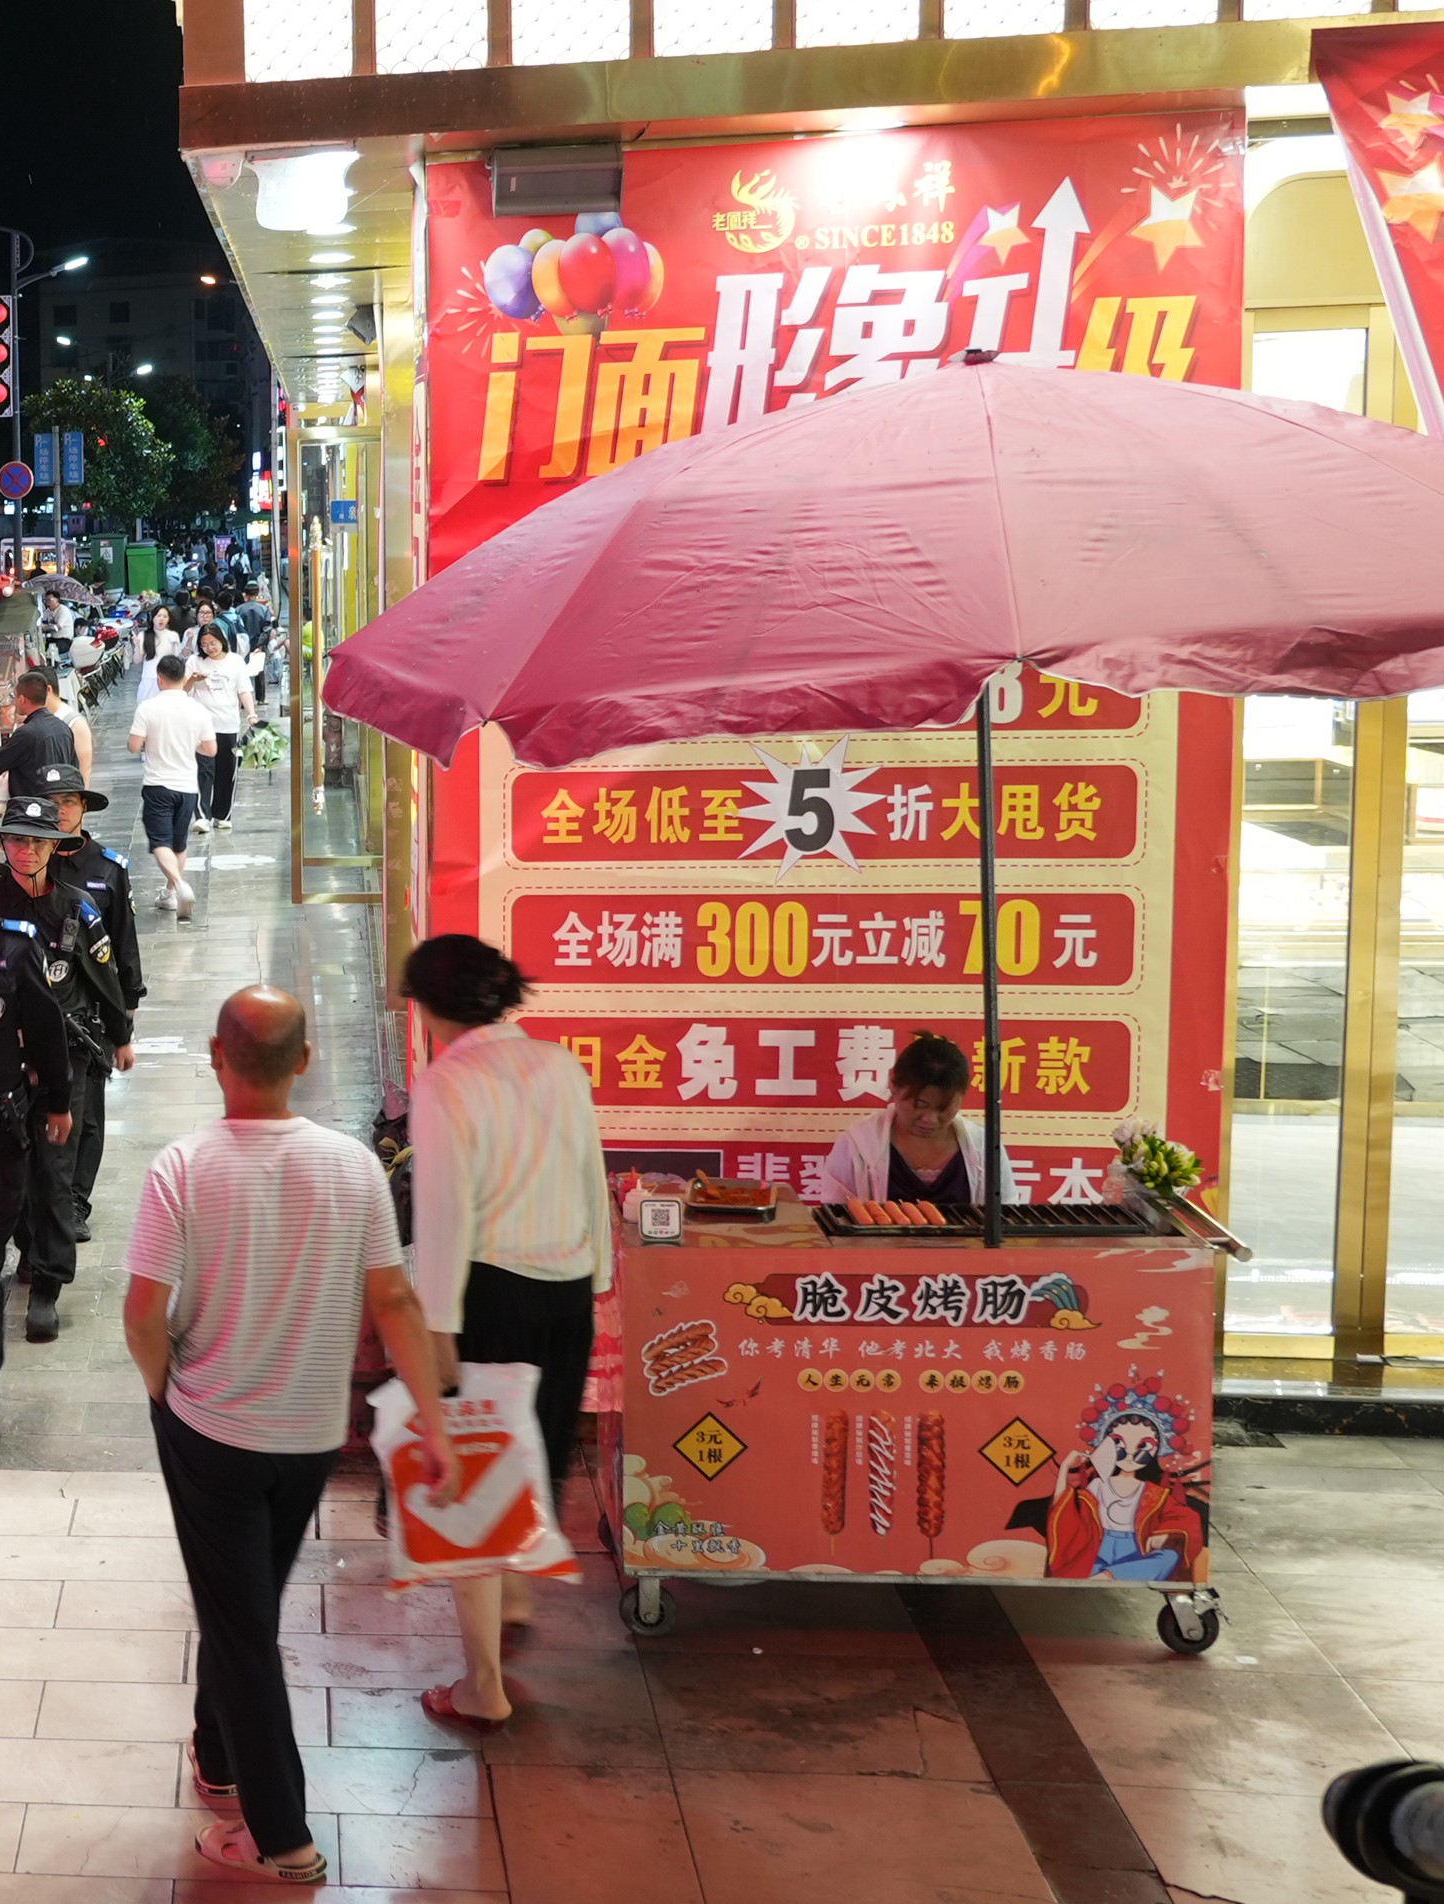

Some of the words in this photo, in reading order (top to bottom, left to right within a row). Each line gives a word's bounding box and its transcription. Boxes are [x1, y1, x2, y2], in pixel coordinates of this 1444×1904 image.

[795, 1275, 1029, 1323] 脆皮烤肠
[738, 1338, 842, 1359] 你考清华
[858, 1340, 963, 1360] 他考北大
[982, 1339, 1088, 1362] 我烤香肠
[696, 1430, 723, 1445] 3元
[1003, 1435, 1031, 1450] 3元
[698, 1448, 723, 1464] 1根
[1004, 1453, 1031, 1469] 1根
[653, 1520, 726, 1537] 金黄酥脆
